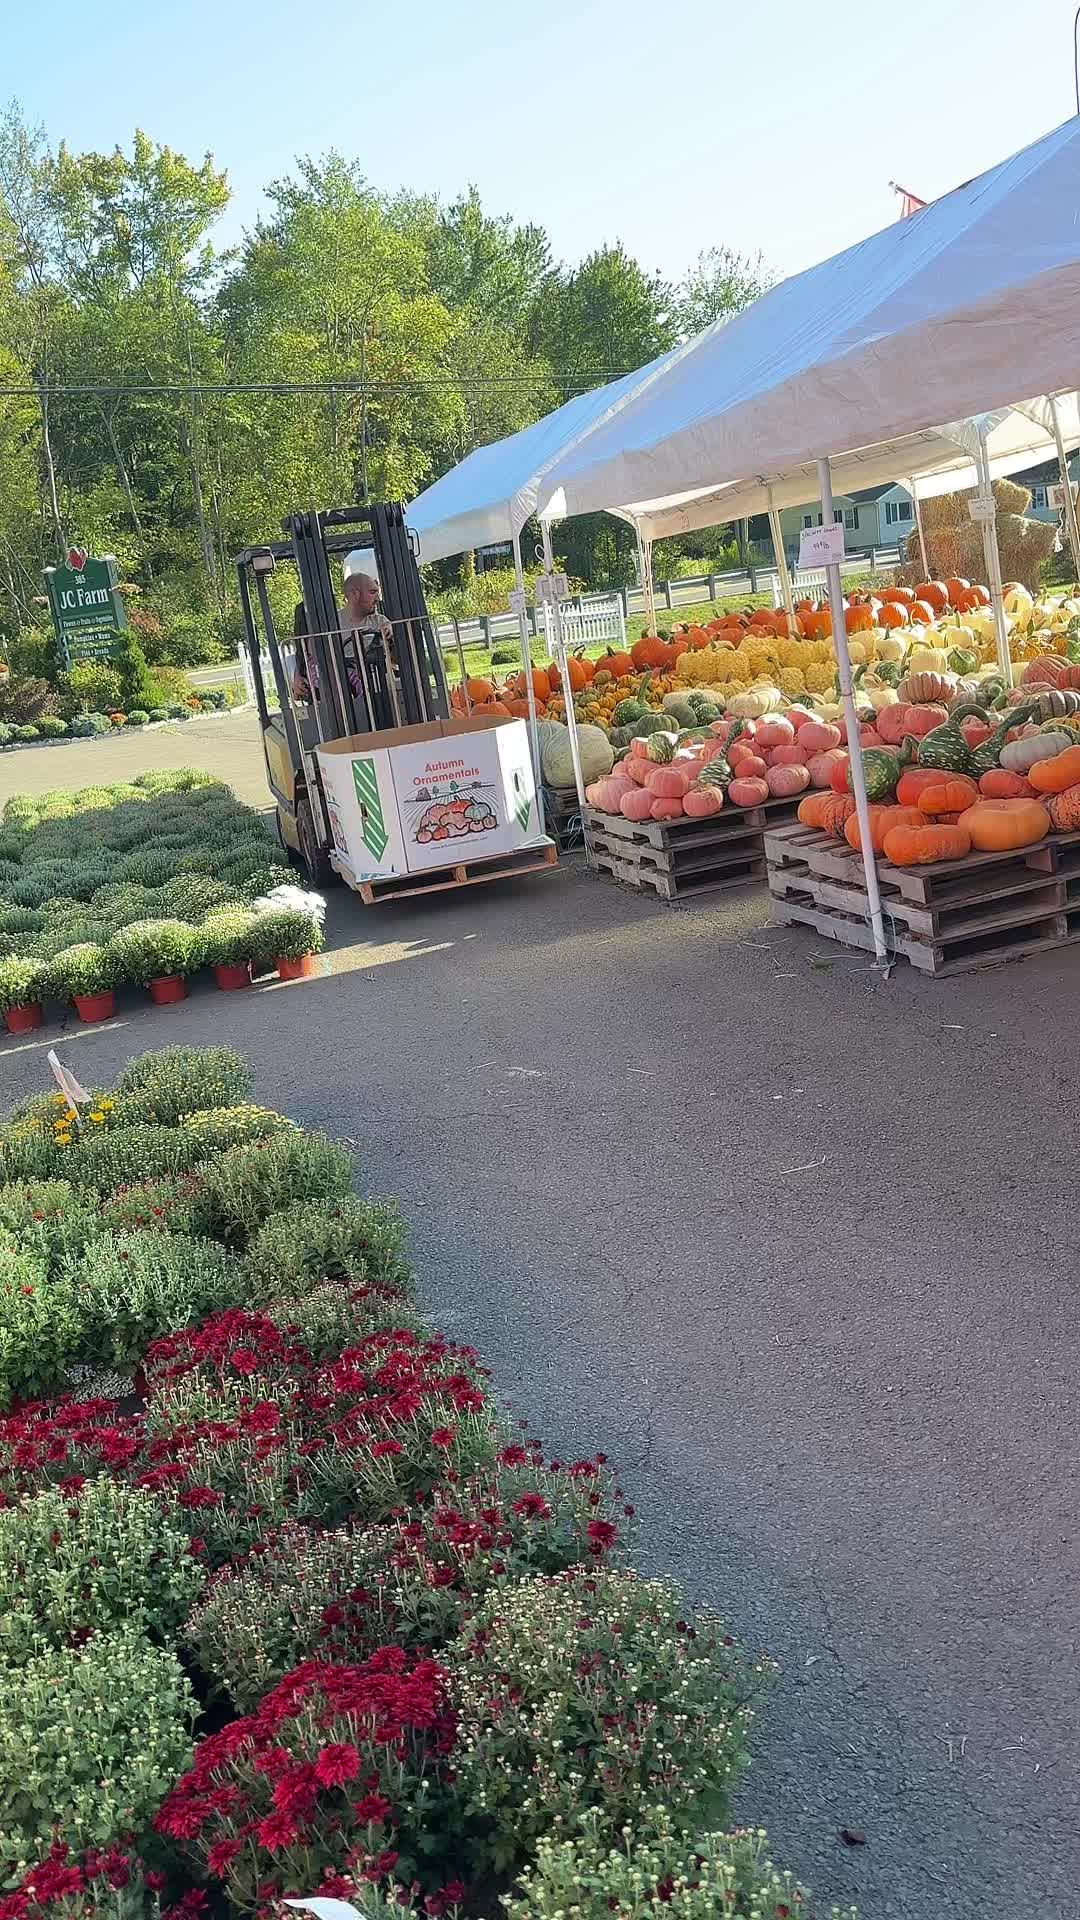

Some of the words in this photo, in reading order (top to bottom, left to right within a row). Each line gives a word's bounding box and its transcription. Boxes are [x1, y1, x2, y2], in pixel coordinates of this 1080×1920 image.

[60, 590, 76, 610] JC
[76, 588, 110, 607] Farm
[424, 759, 465, 773] Autumn
[412, 767, 480, 786] Ornamentals
